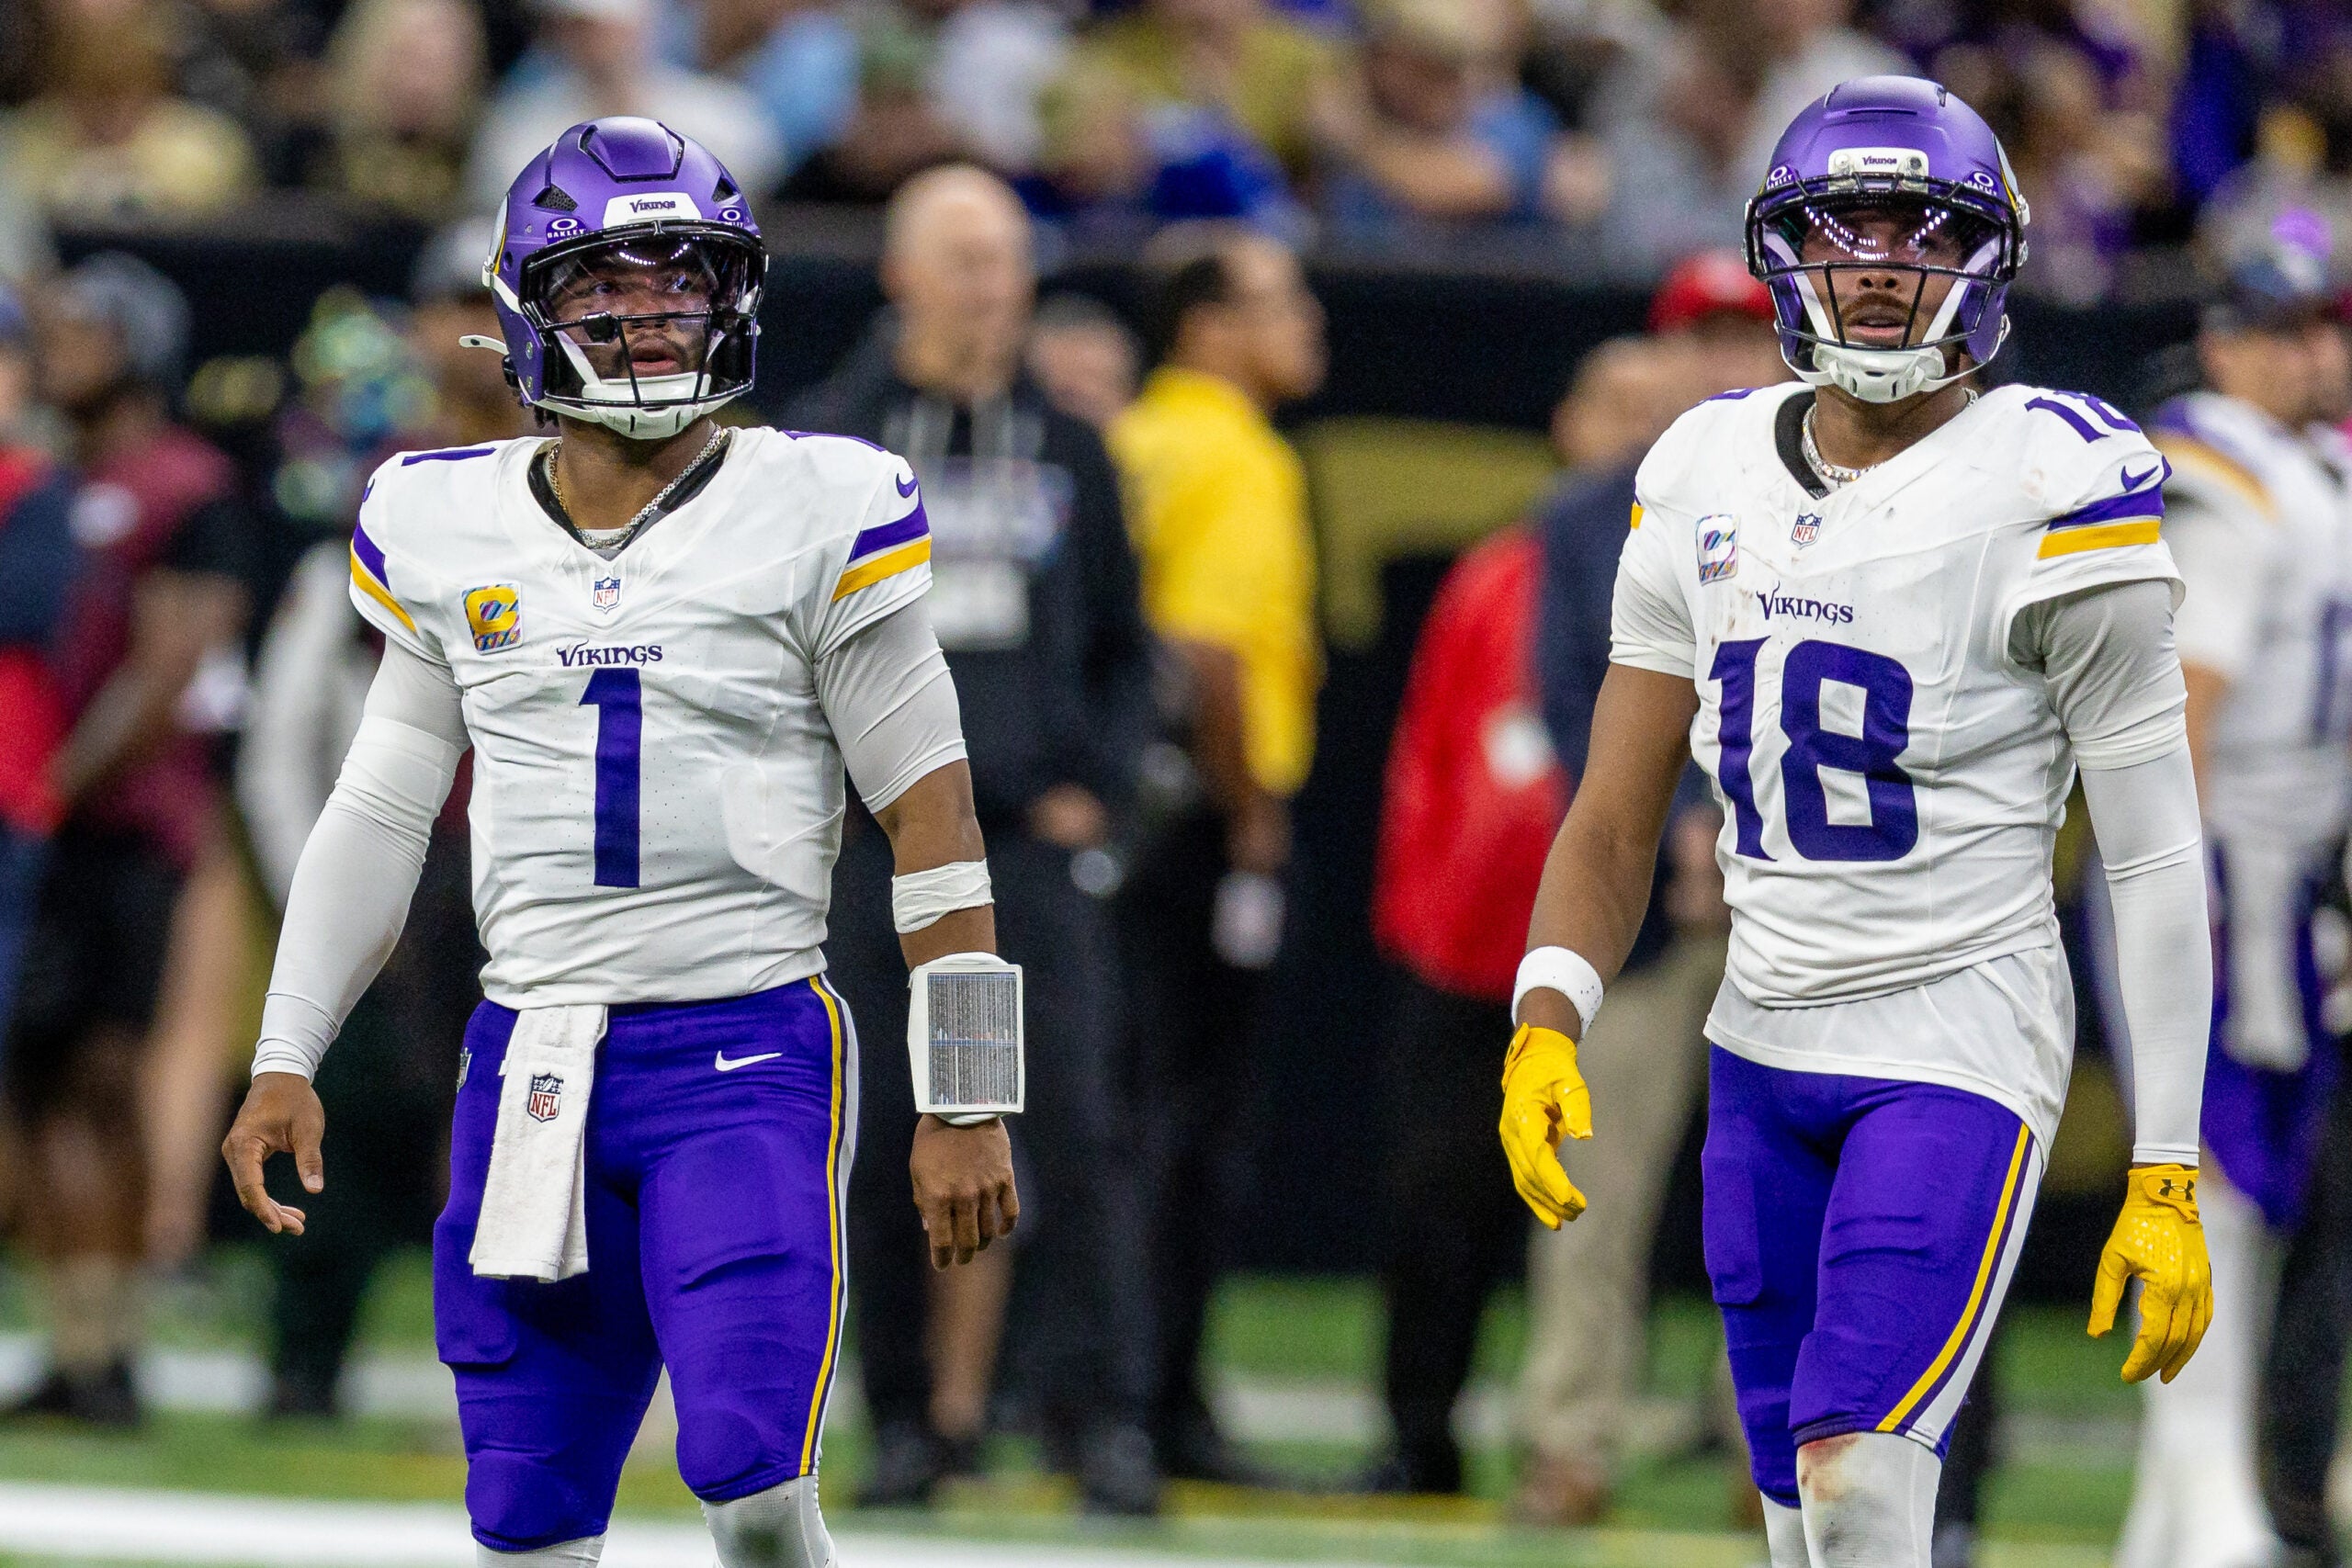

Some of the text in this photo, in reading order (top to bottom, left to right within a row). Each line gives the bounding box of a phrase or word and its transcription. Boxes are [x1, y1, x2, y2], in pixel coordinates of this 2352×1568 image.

[547, 229, 586, 239] OAKLEY
[1794, 525, 1815, 542] NFL
[596, 588, 616, 605] NFL
[1757, 581, 1854, 626] VIKINGS
[557, 639, 663, 667] VIKINGS
[1708, 636, 1919, 862] 18
[579, 668, 643, 888] 1
[530, 1092, 557, 1118] NFL
